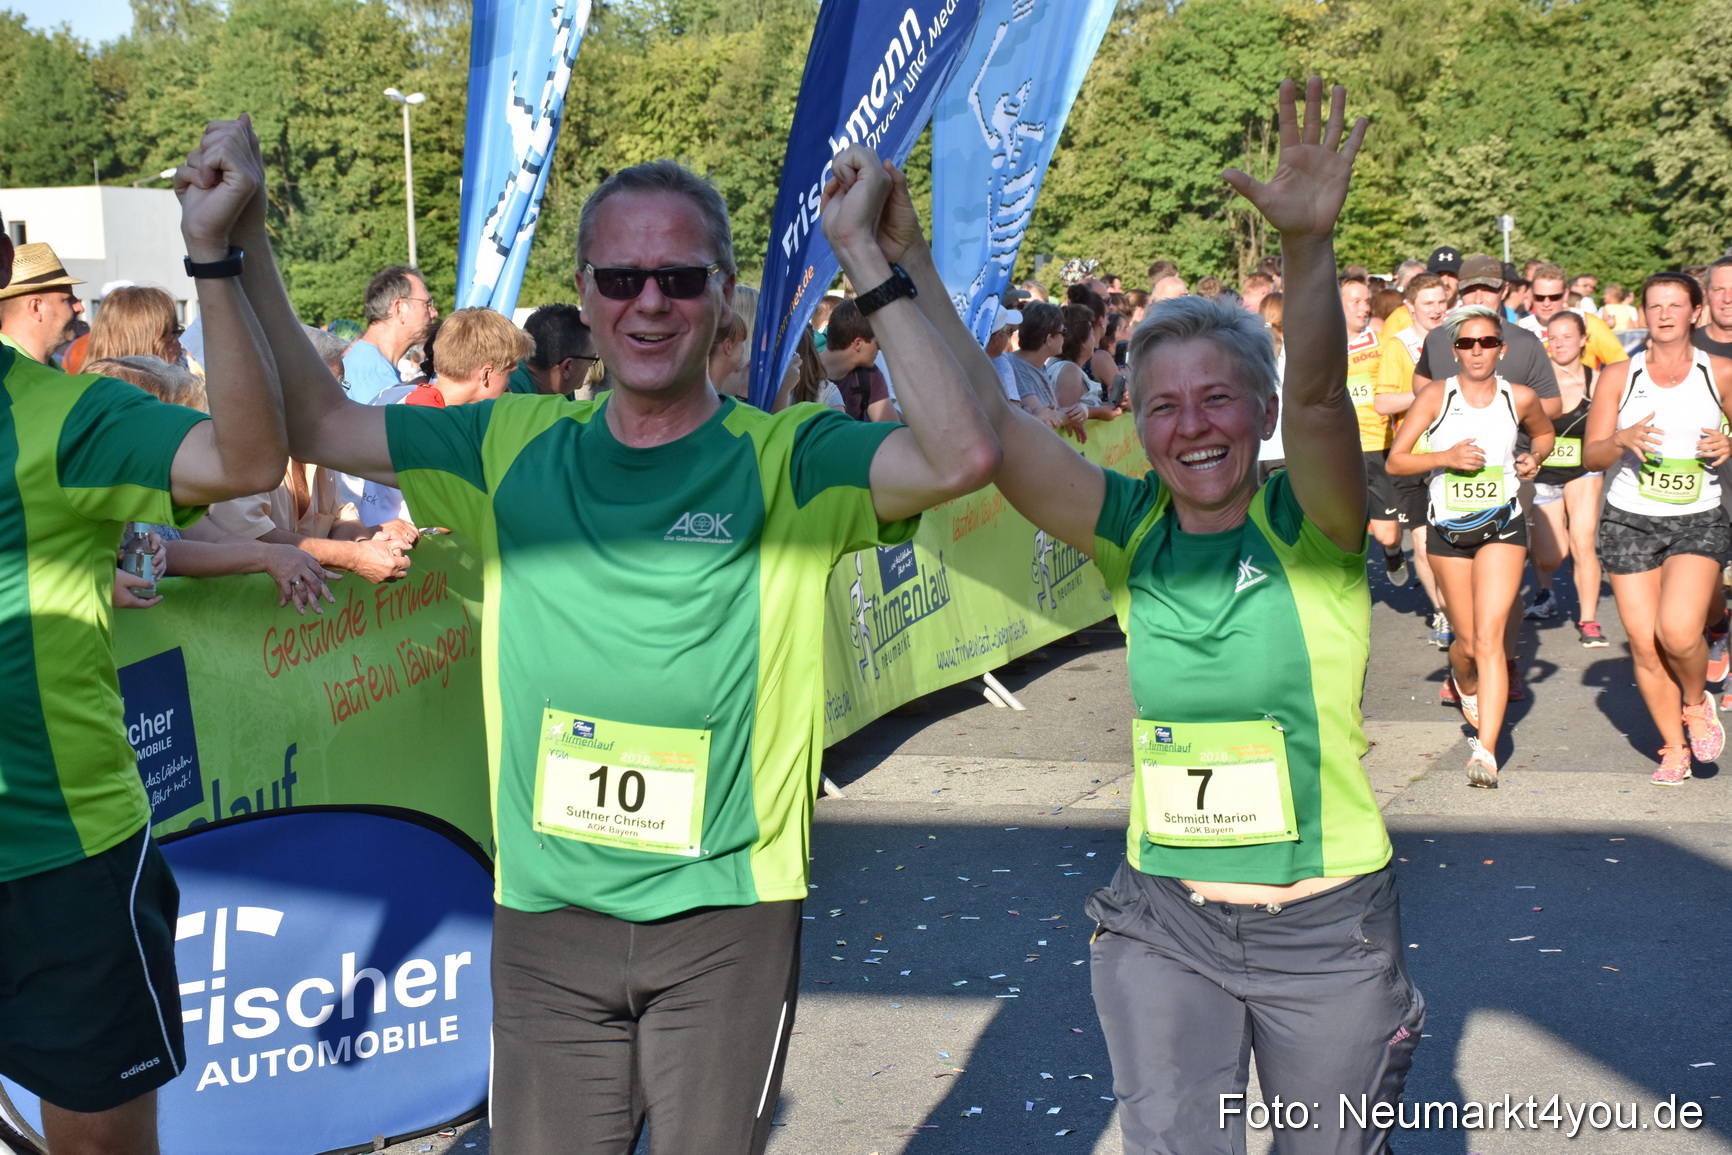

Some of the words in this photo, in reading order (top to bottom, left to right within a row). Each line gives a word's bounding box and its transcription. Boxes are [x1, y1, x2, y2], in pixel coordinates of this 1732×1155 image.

[903, 40, 927, 93] und
[1351, 385, 1368, 397] 45
[1550, 445, 1574, 457] 62
[1452, 482, 1497, 498] 1552
[1648, 471, 1695, 490] 1553
[666, 512, 733, 538] AOK
[872, 549, 952, 648] firmenlauf
[263, 588, 367, 679] Gesunde
[374, 571, 449, 630] Firmen
[323, 654, 400, 726] laufen
[396, 604, 475, 688] länger!
[127, 708, 175, 746] cher
[136, 735, 172, 762] MOBILE
[562, 731, 615, 752] firmenlauf
[1149, 740, 1192, 753] firmenlauf
[145, 771, 160, 789] das
[589, 765, 646, 813] 10
[1187, 768, 1213, 811] 7
[566, 805, 611, 823] Suttner
[614, 814, 666, 830] Christof
[1164, 812, 1210, 824] Schmidt
[1213, 812, 1257, 824] Marion
[587, 822, 607, 833] AOK
[608, 826, 639, 838] Bayern
[1184, 826, 1203, 834] AOK
[1204, 826, 1234, 836] Bayern
[195, 1015, 460, 1092] AUTOMOBILE
[120, 1057, 160, 1079] adidas
